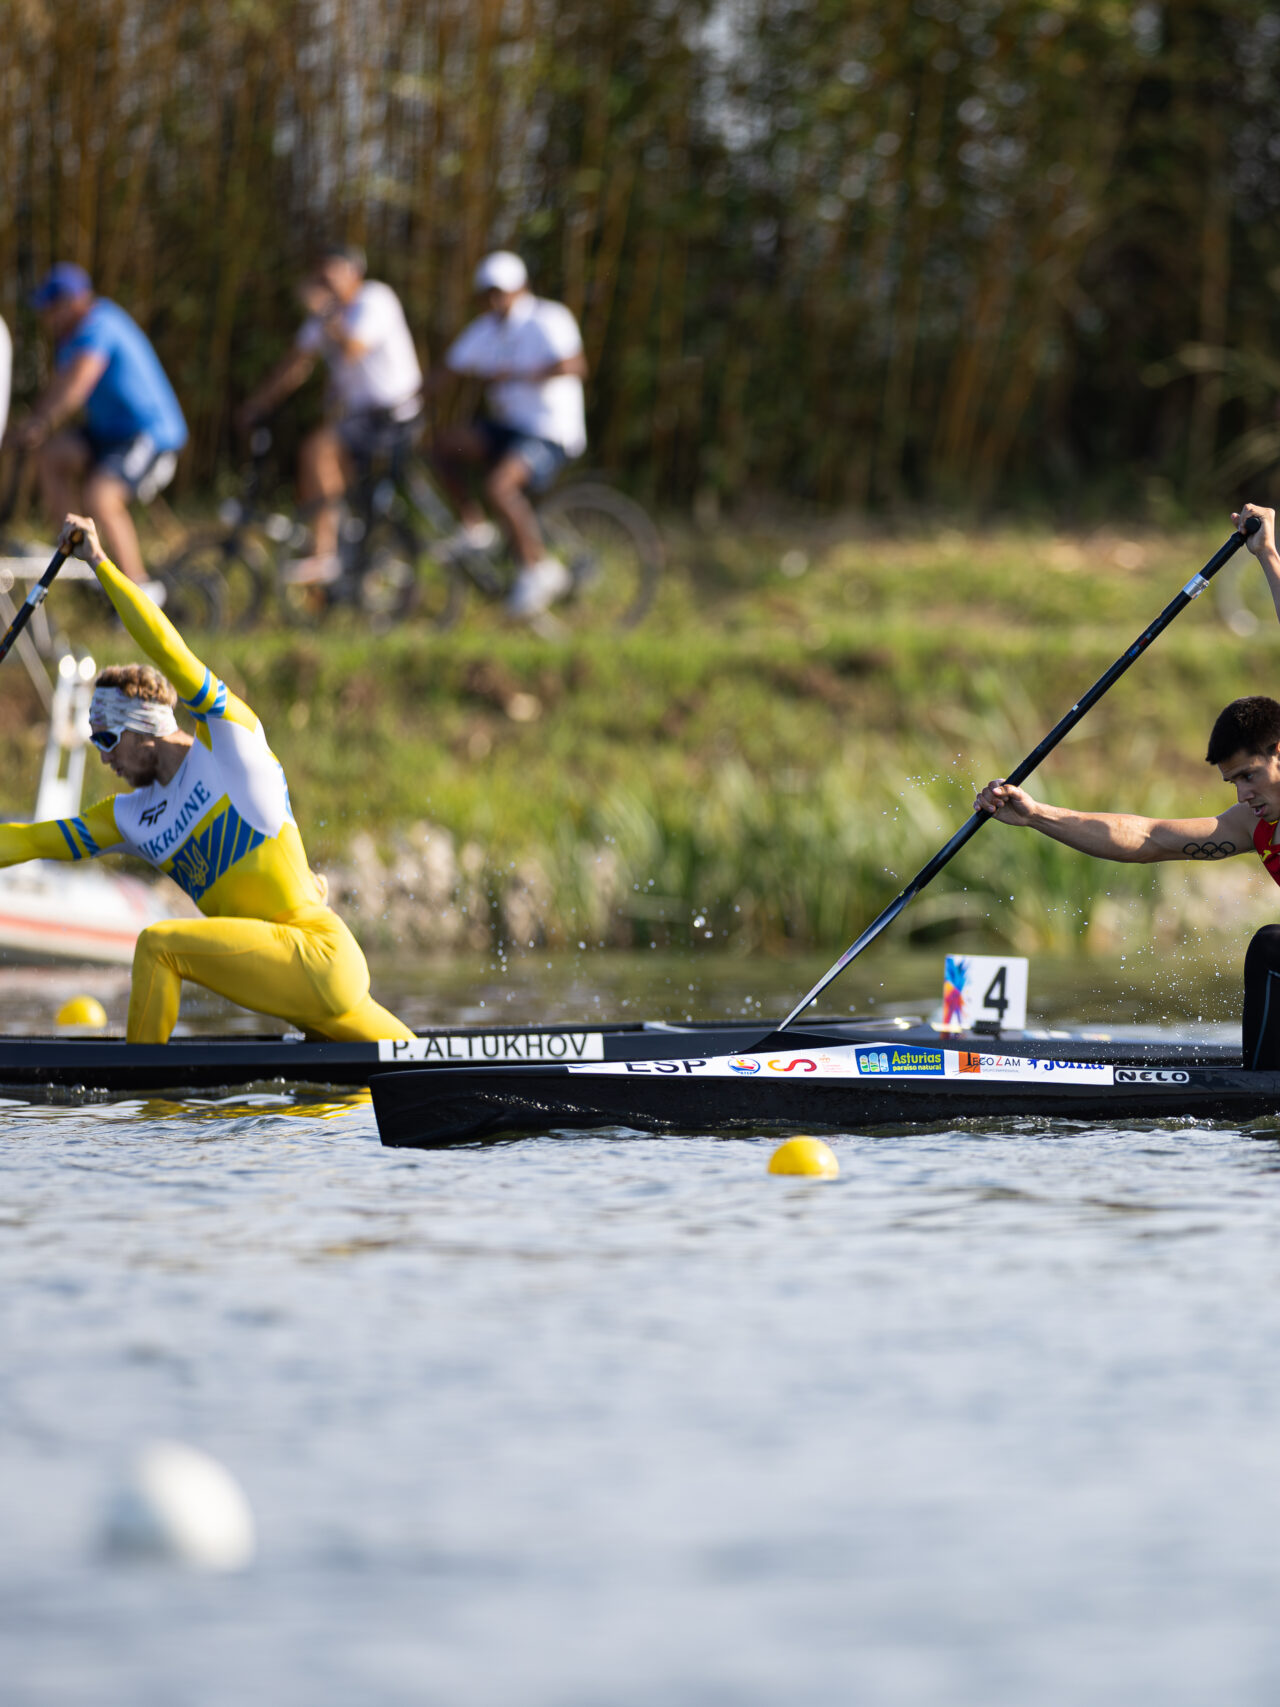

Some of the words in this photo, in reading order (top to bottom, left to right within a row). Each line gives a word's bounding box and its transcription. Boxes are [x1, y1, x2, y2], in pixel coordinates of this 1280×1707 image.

[983, 966, 1009, 1021] 4
[391, 1040, 415, 1059] P.
[424, 1034, 589, 1059] ALTUKHOV
[891, 1050, 942, 1065] Asturias
[624, 1059, 707, 1074] ESP
[917, 1063, 942, 1071] natural
[1118, 1070, 1188, 1083] NELO
